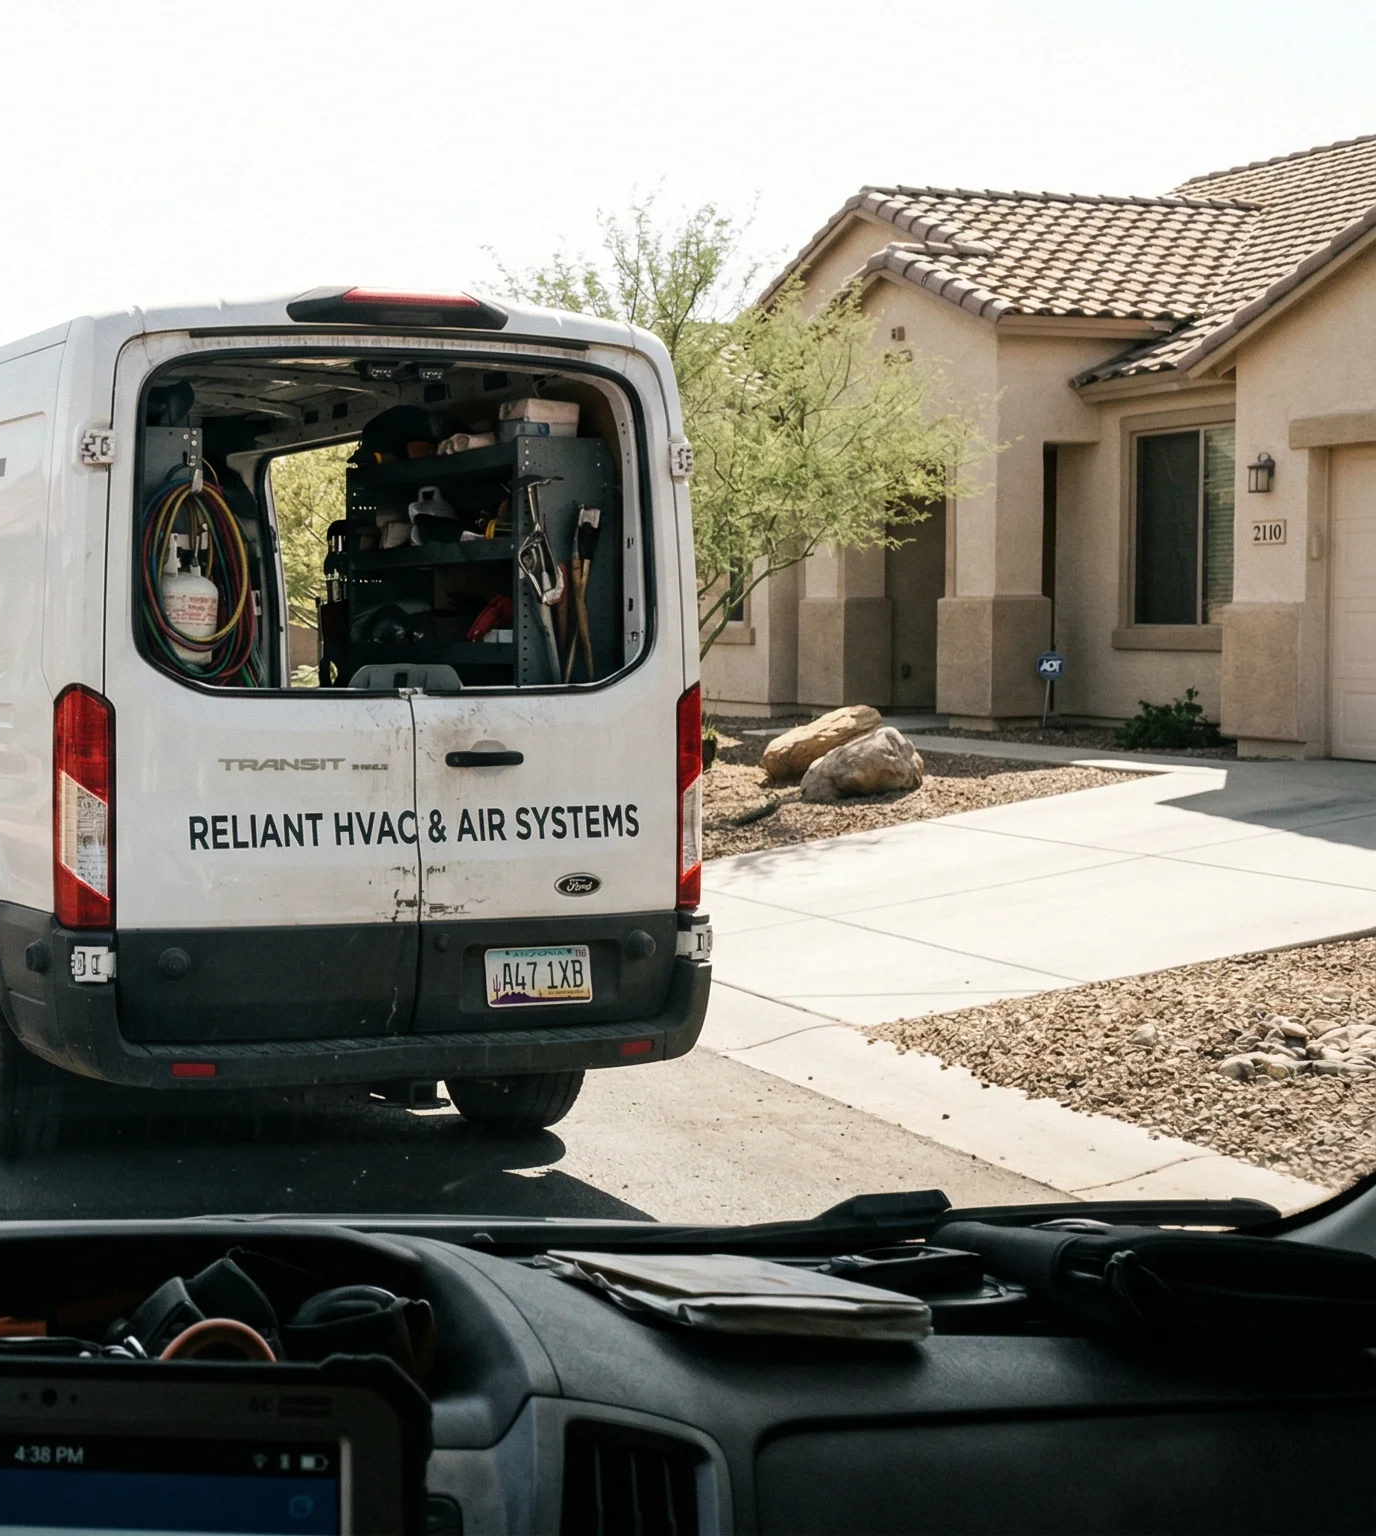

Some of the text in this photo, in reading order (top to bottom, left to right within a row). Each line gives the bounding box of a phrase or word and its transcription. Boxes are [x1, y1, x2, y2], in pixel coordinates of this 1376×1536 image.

[1253, 525, 1282, 542] 2110
[218, 758, 346, 772] TRANSIT
[188, 803, 640, 851] RELIANT HVAC & AIR SYSTEMS
[503, 960, 584, 992] A47 1XB
[14, 1445, 84, 1464] 4:38 PM
